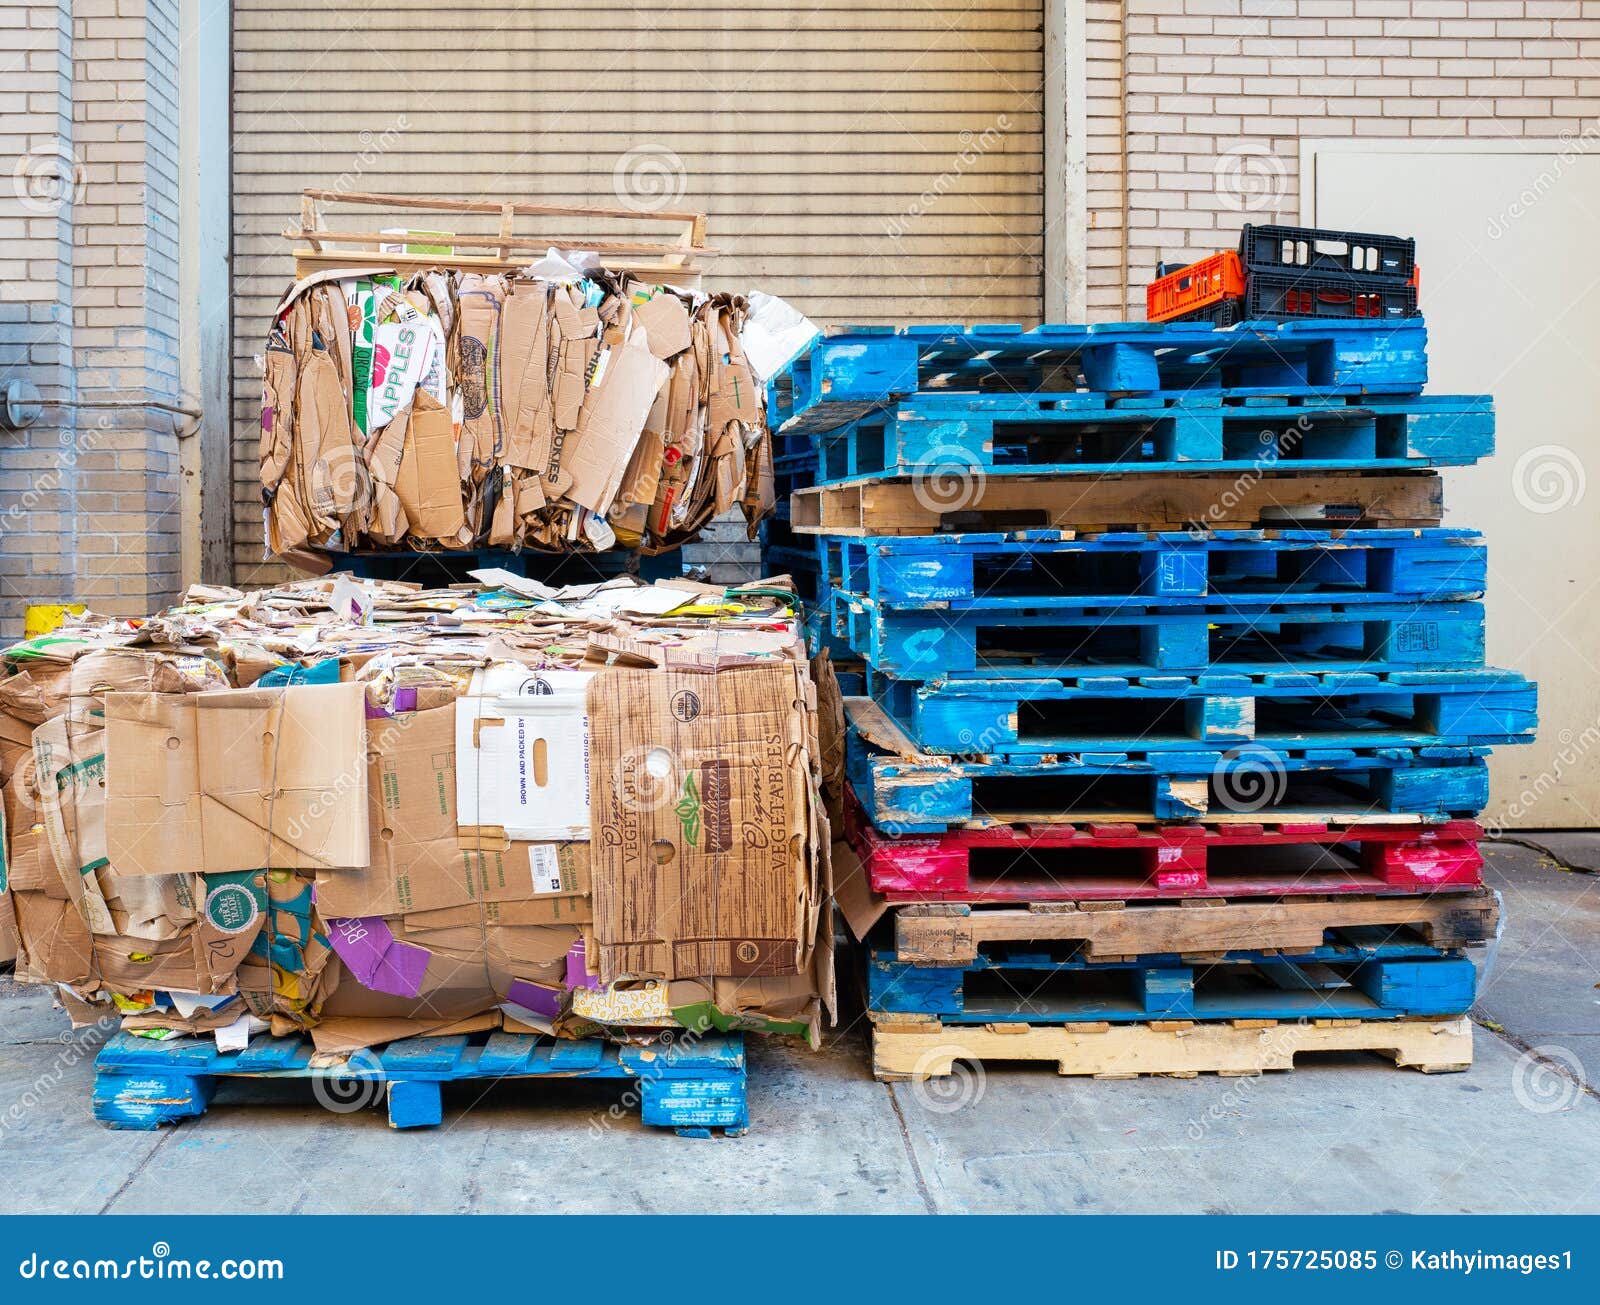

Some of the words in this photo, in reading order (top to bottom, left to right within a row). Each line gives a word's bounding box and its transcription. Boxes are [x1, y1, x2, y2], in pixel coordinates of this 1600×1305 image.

[381, 327, 416, 418] APPLES
[518, 717, 526, 728] BY
[518, 729, 527, 759] PACKED
[519, 761, 527, 775] AND
[601, 772, 622, 847] Organic
[623, 755, 639, 863] VEGETABLES
[718, 775, 730, 836] HARVEST
[741, 756, 769, 850] Organic
[766, 733, 786, 872] VEGETABLES
[220, 895, 233, 926] WHOLE
[227, 894, 240, 924] TRADE
